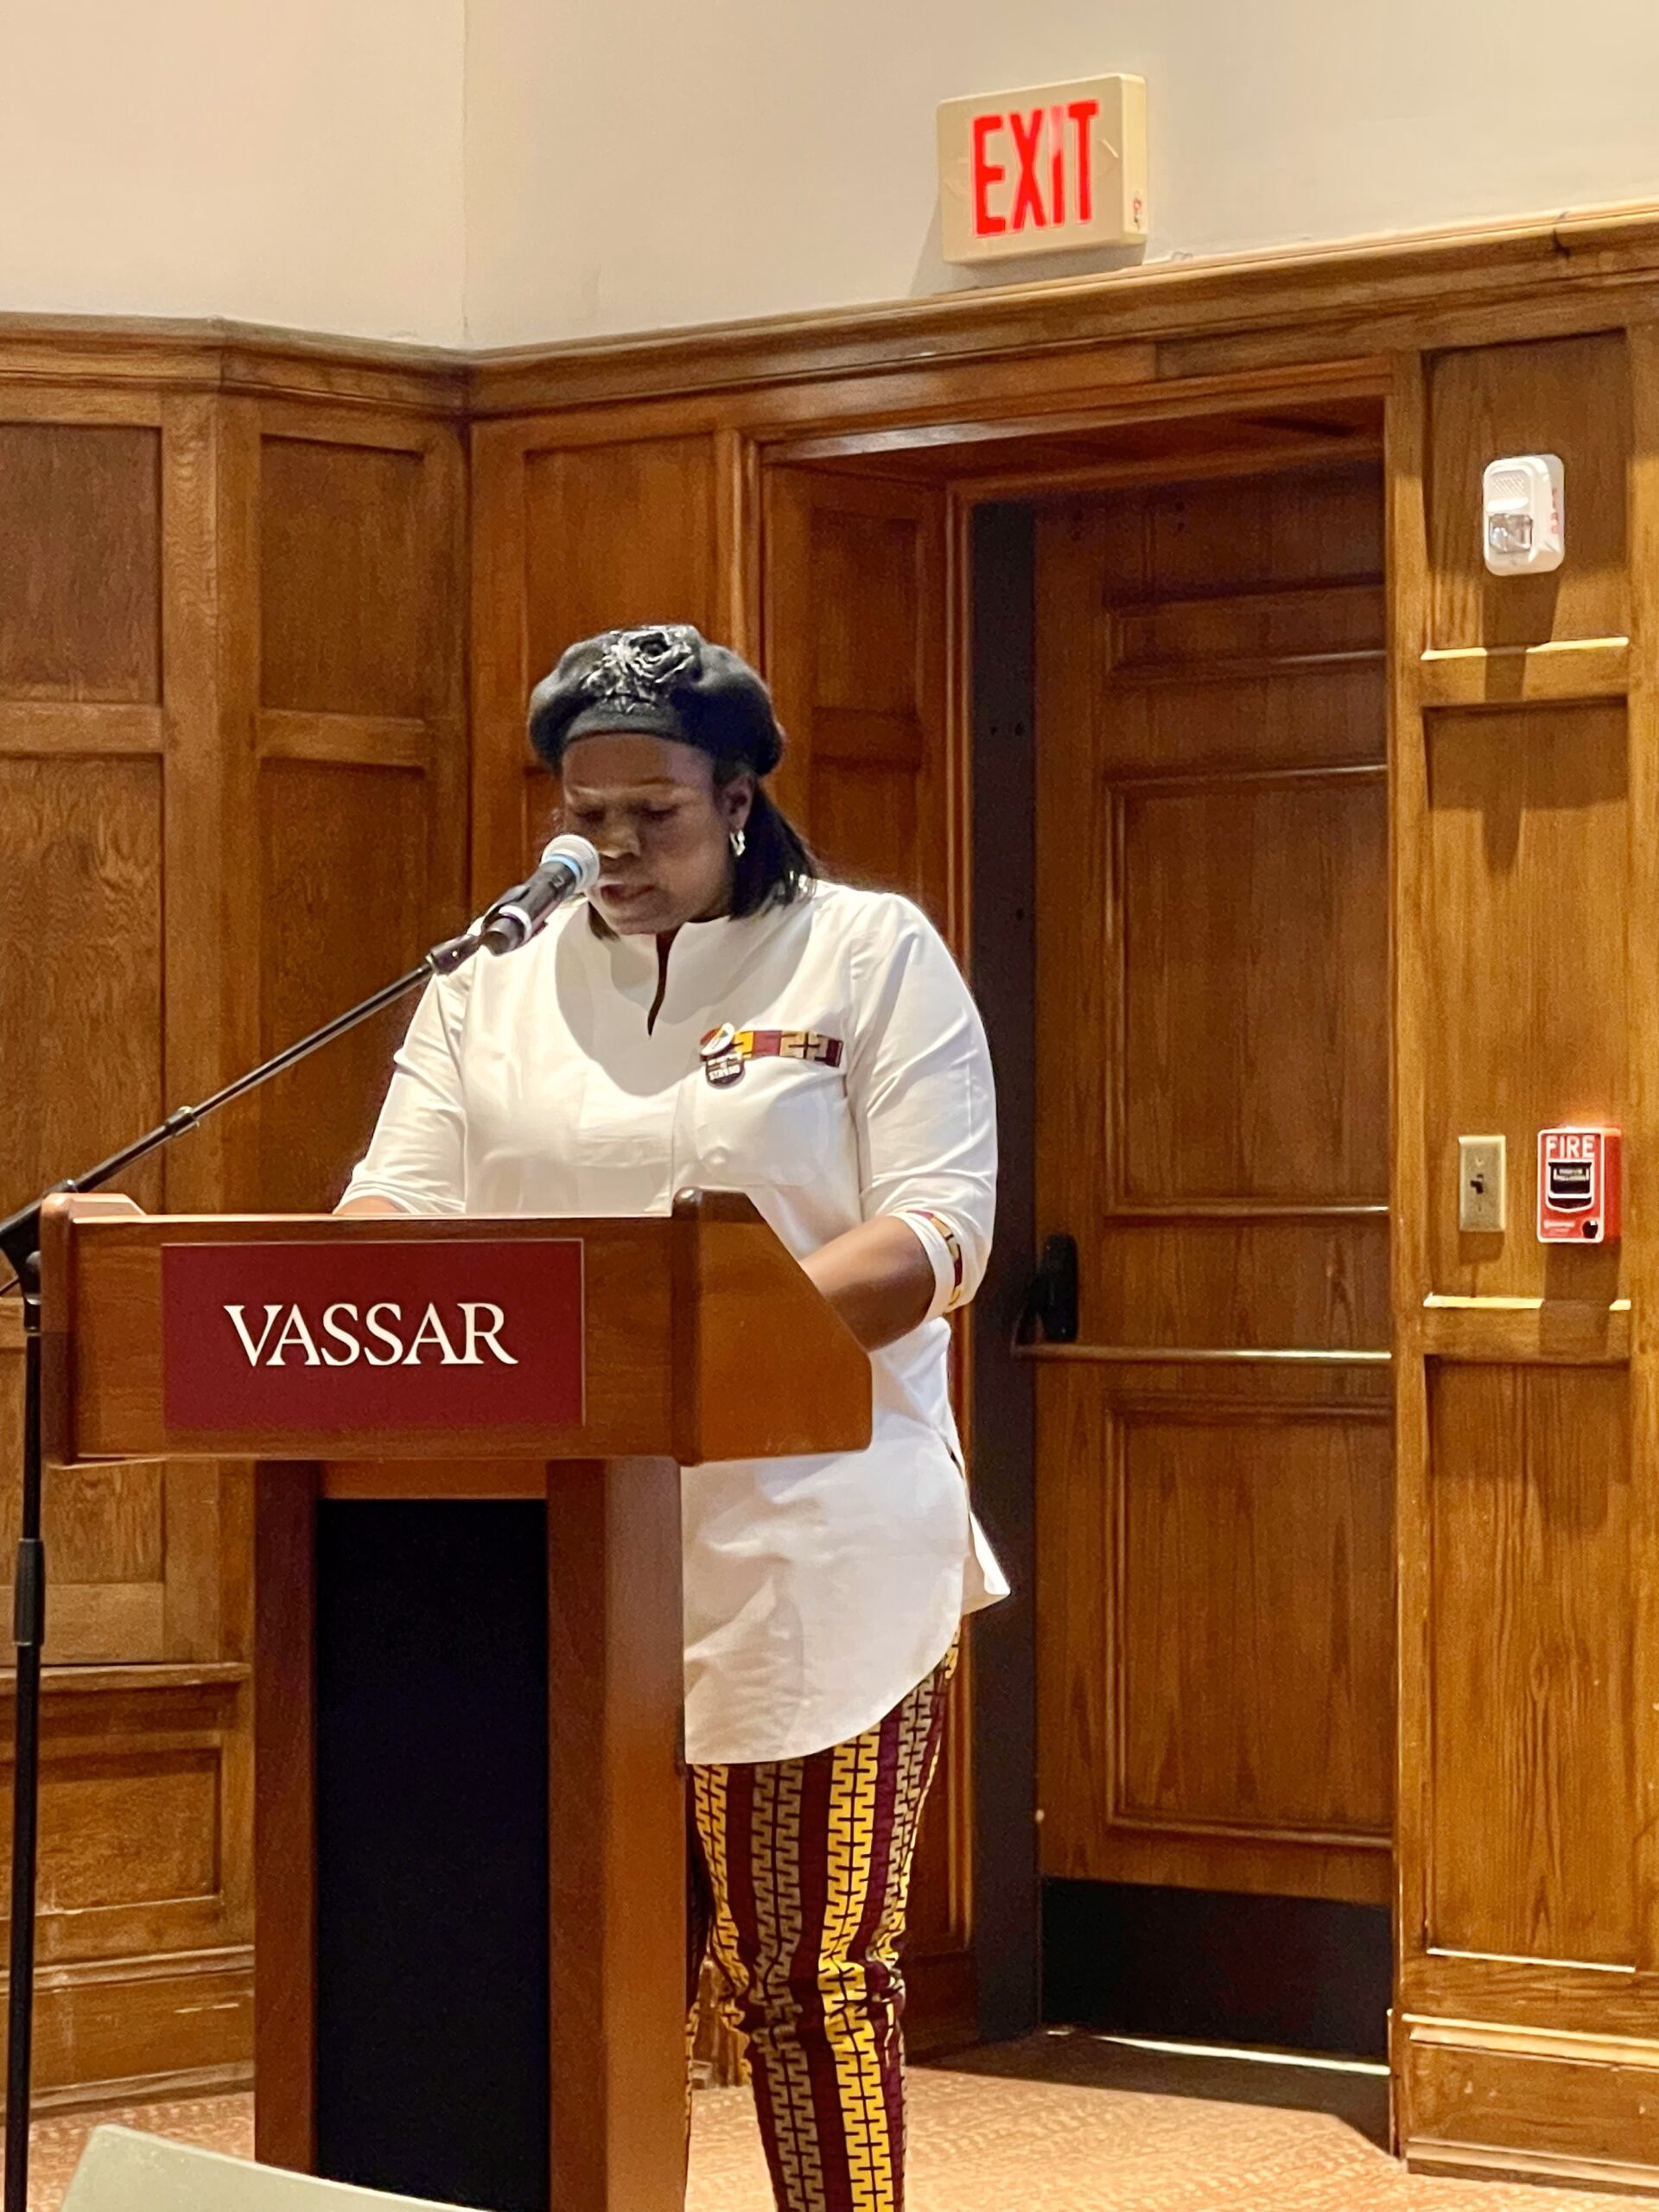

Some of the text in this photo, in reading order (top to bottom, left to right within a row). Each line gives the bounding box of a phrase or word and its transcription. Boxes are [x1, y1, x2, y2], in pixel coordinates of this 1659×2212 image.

[972, 99, 1098, 237] EXIT
[1546, 1135, 1595, 1159] FIRE
[223, 1302, 518, 1367] VASSAR
